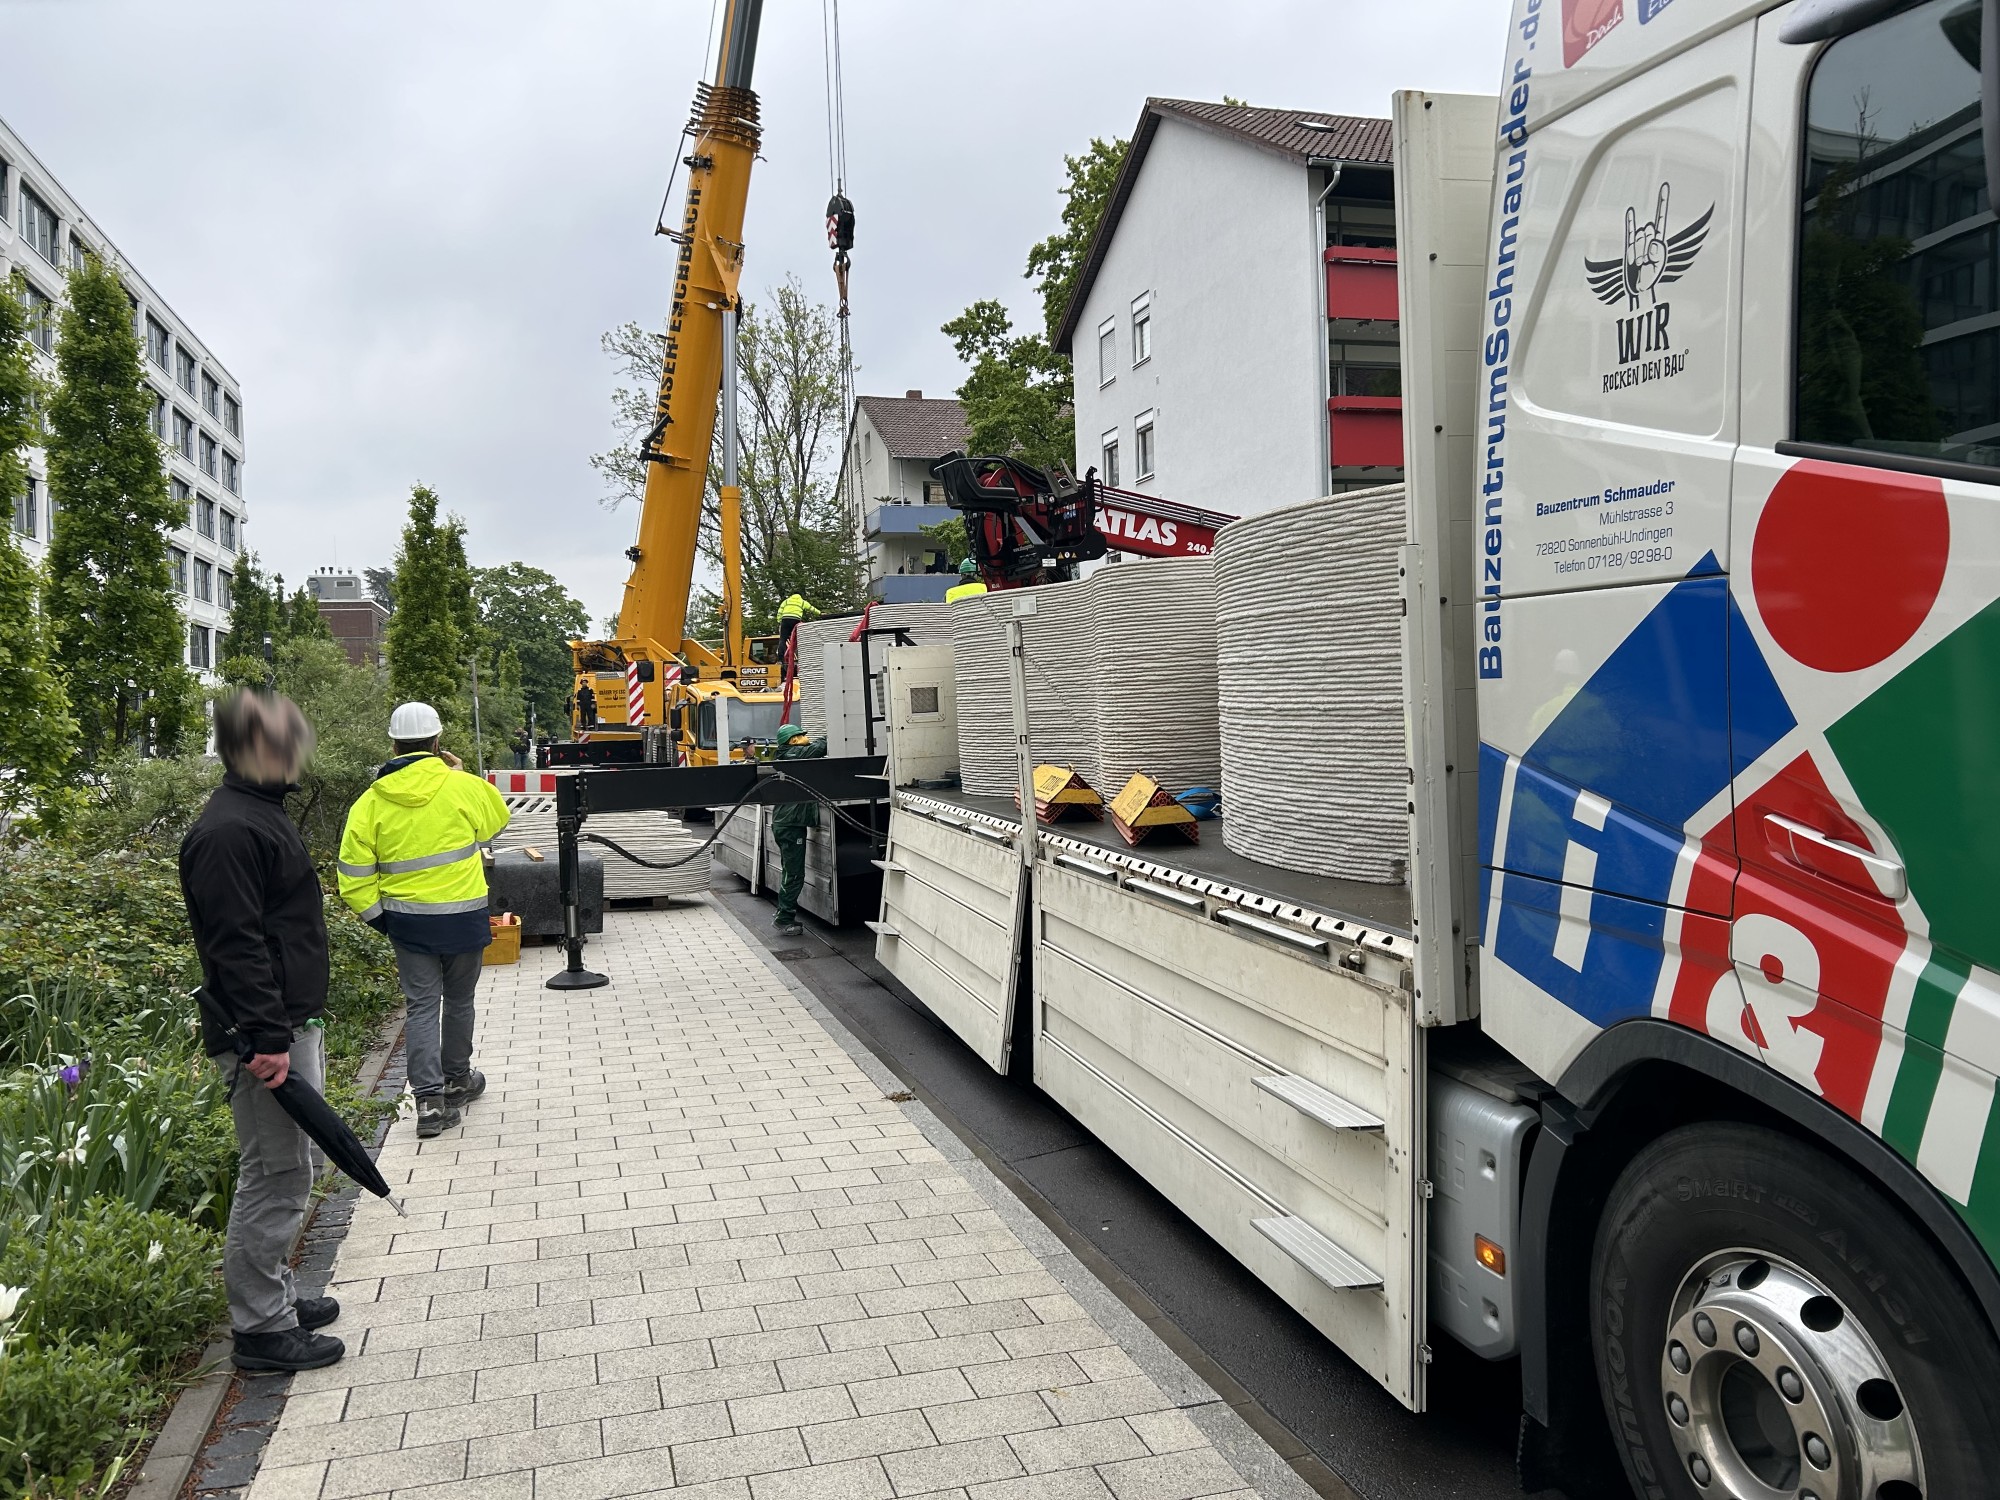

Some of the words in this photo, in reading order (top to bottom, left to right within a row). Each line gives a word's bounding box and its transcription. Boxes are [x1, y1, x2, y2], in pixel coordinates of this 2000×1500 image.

[1585, 5, 1623, 49] Dach
[1616, 302, 1670, 364] WIR
[1602, 366, 1640, 393] ROCKEN
[1641, 359, 1661, 383] DEN
[1536, 494, 1600, 516] Bauzentrum
[1604, 479, 1675, 504] Schmauder
[1600, 505, 1663, 526] Mühlstrasse
[1665, 501, 1674, 515] 3
[1093, 508, 1178, 547] ATLAS
[1536, 540, 1567, 556] 72820
[1568, 527, 1673, 552] Sonnenbühl-Undingen
[1554, 560, 1585, 574] Telefon
